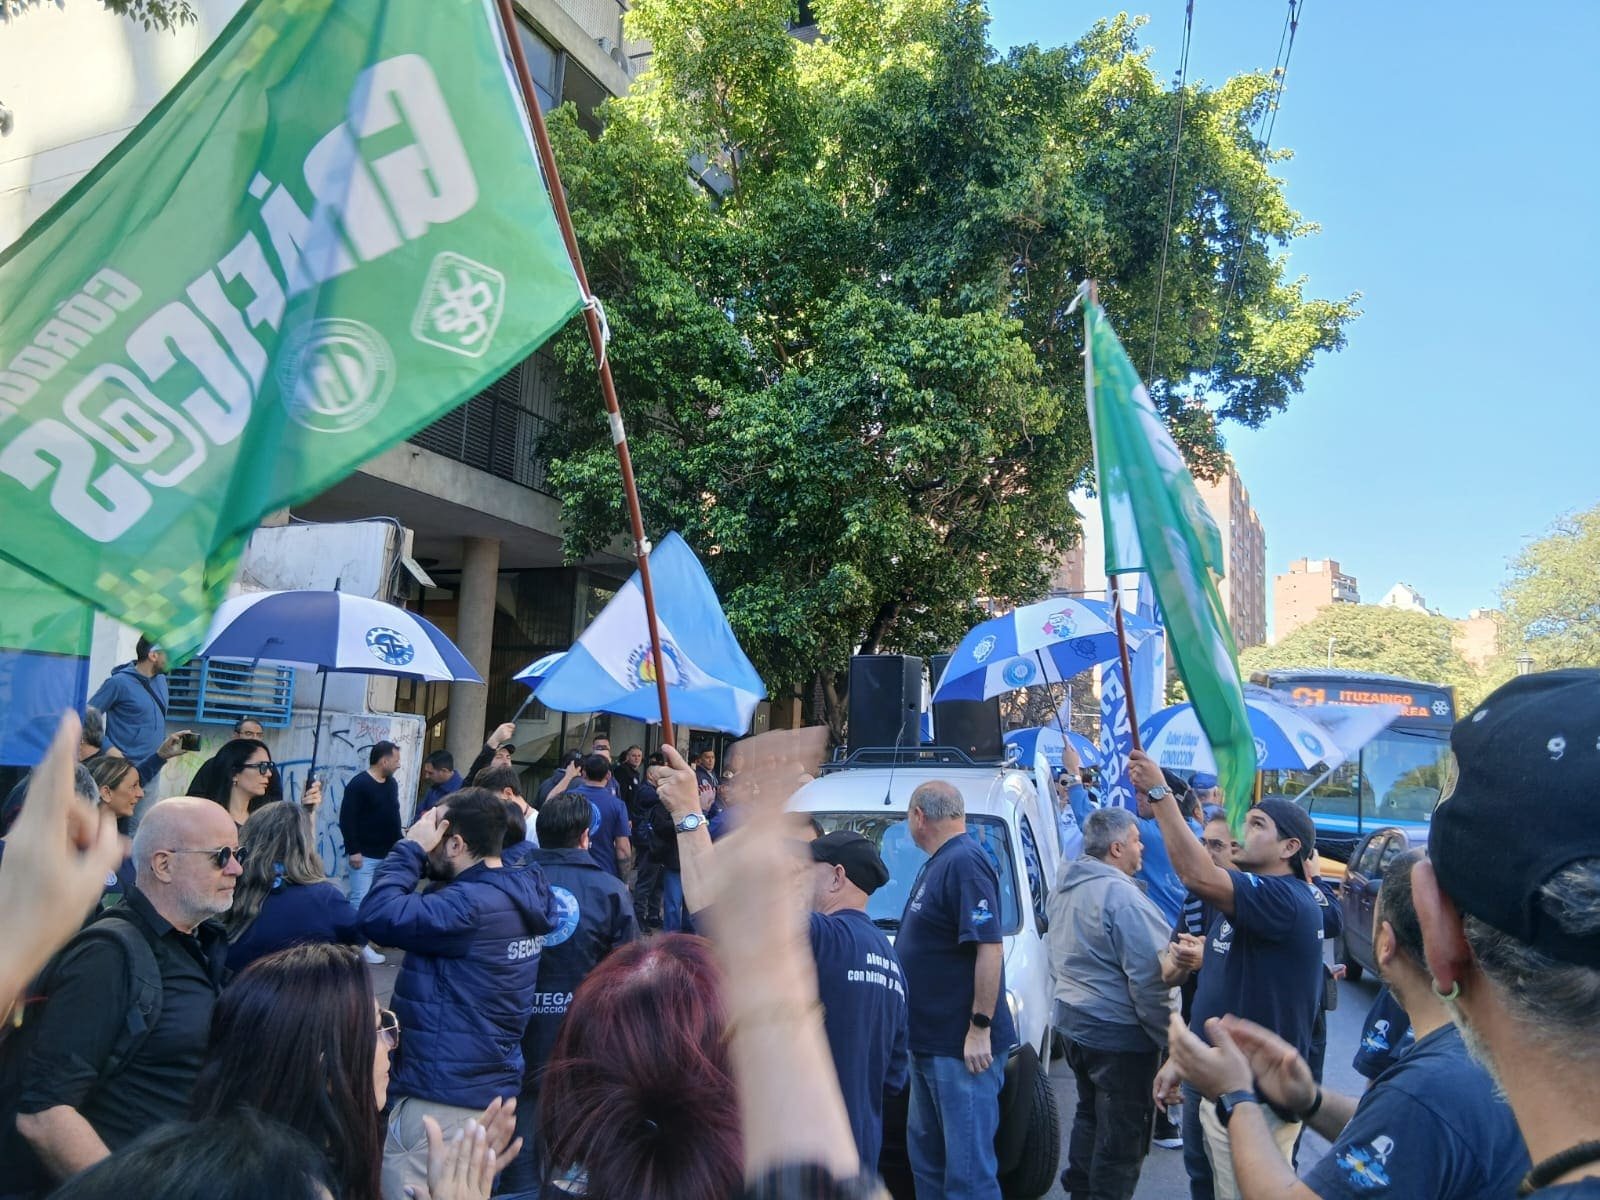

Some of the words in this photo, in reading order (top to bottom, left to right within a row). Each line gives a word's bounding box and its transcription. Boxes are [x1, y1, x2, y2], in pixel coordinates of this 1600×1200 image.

[1339, 690, 1413, 705] ITUZAINGO
[534, 992, 573, 1005] TEGA
[532, 1006, 567, 1014] DUCCIO
